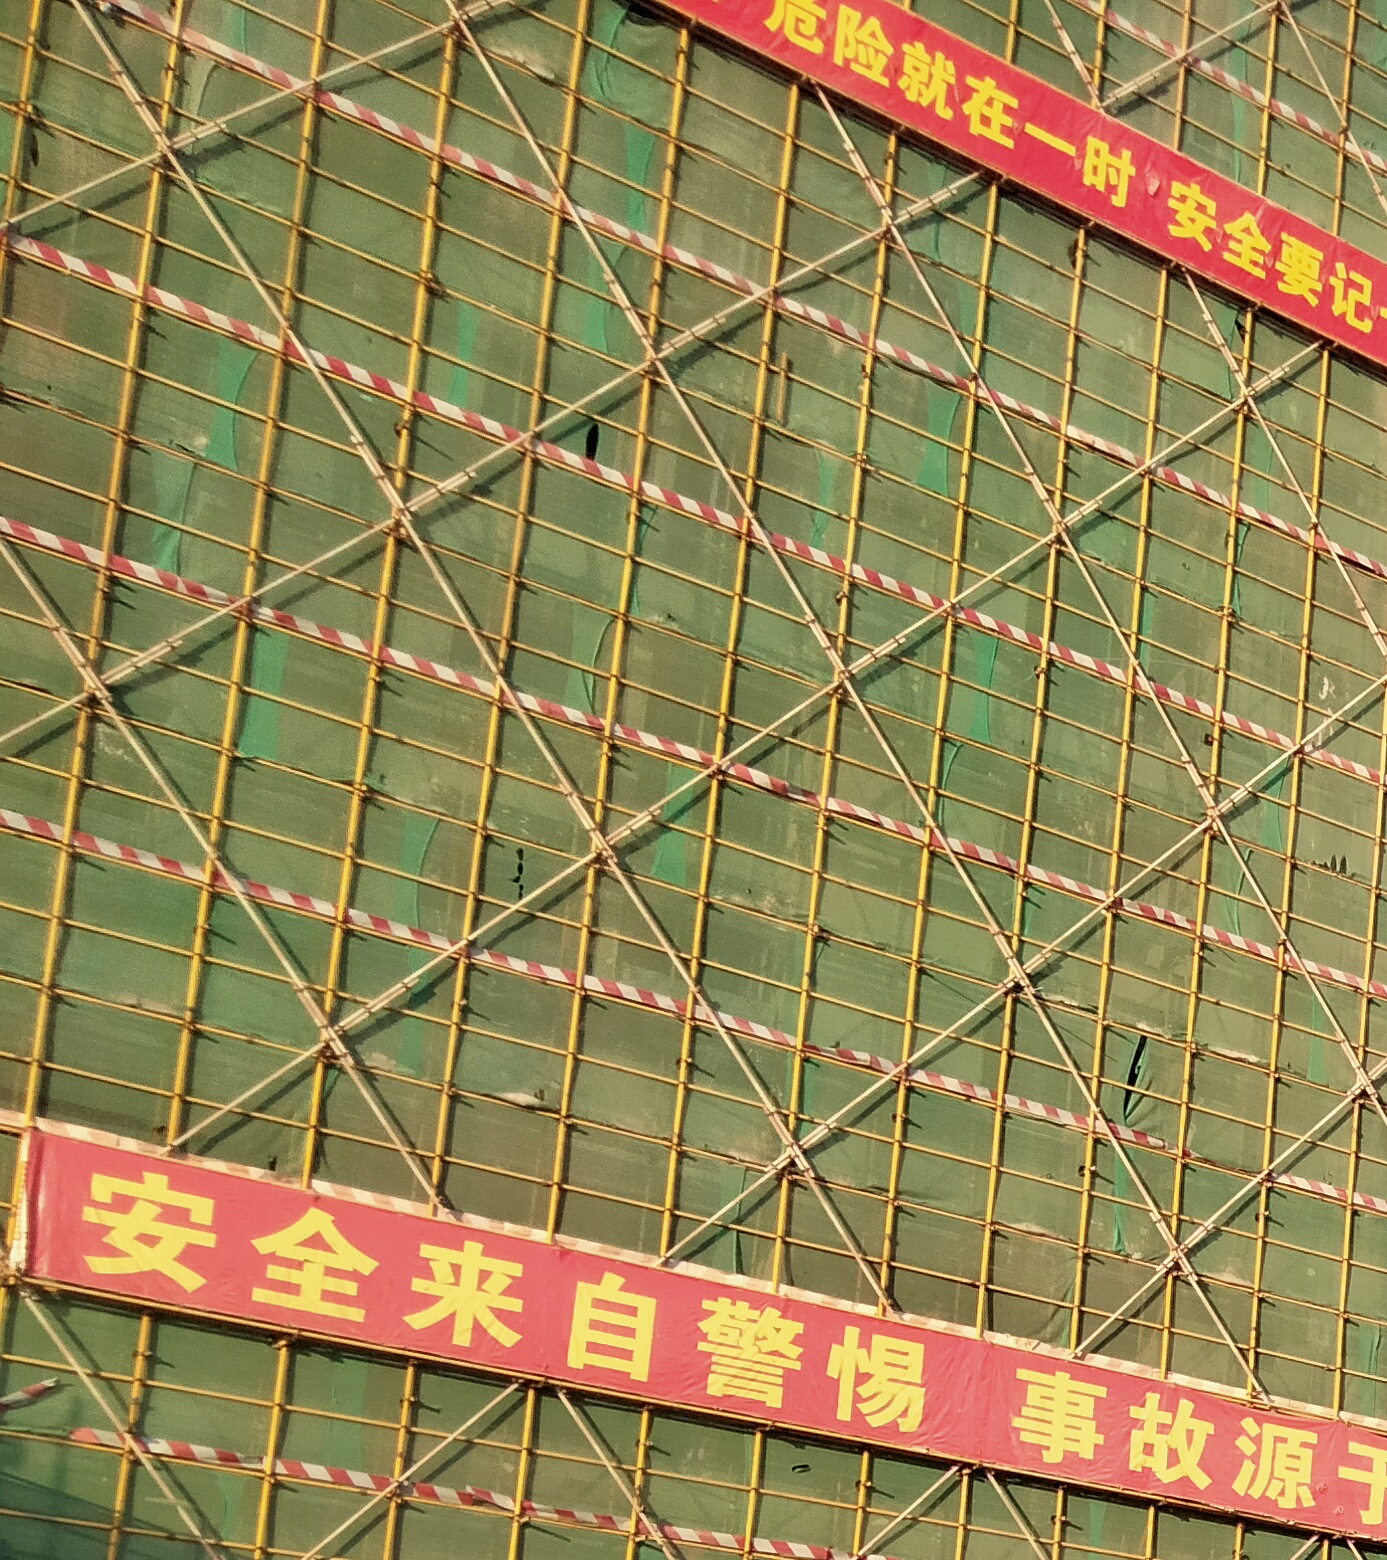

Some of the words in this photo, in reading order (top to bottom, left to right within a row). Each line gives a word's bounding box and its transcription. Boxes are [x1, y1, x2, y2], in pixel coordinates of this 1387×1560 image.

[763, 0, 1136, 207] 危险就在一时
[81, 1170, 926, 1434] 安全来自警惕
